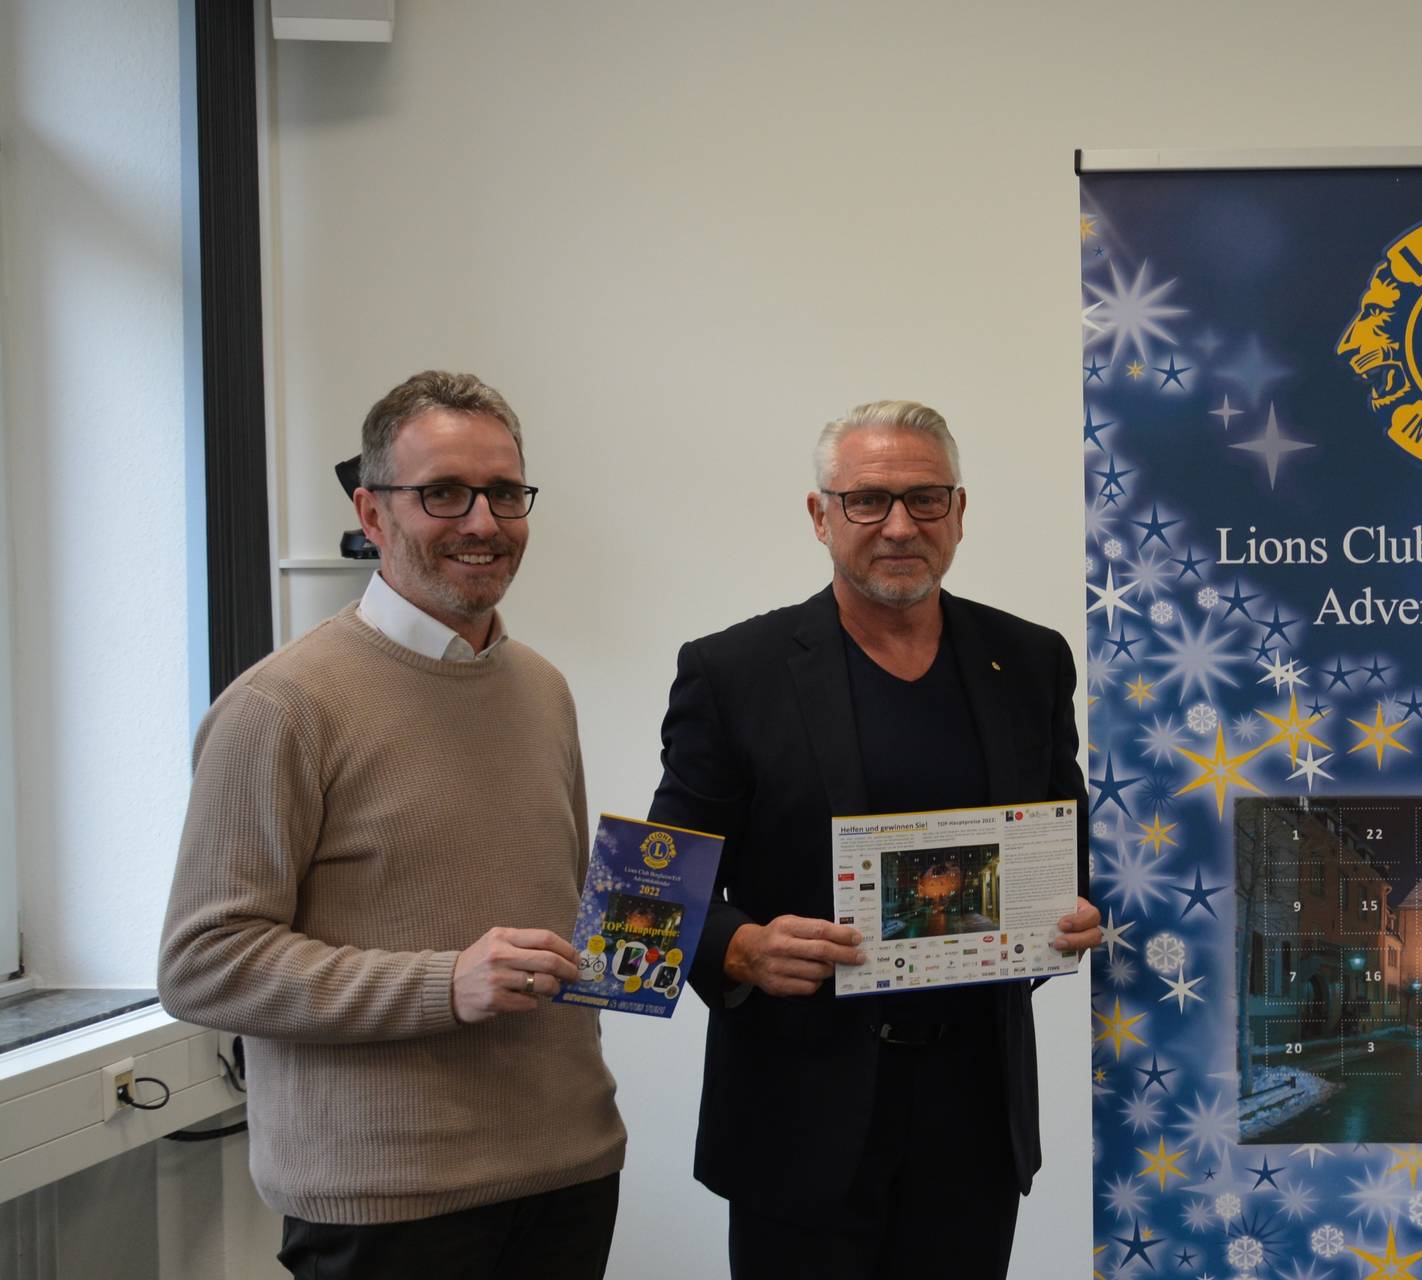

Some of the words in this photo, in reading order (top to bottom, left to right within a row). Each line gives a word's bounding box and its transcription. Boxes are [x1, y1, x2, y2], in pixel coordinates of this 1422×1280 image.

[1216, 526, 1328, 565] Lions
[865, 824, 879, 832] und
[880, 822, 914, 832] gewinnen
[915, 821, 928, 829] Sie!
[1292, 830, 1300, 840] 1
[1366, 829, 1383, 839] 22
[654, 843, 663, 856] L
[639, 885, 660, 896] 2022
[1293, 901, 1301, 911] 9
[1362, 901, 1378, 911] 15
[1289, 972, 1297, 982] 7
[1365, 971, 1382, 981] 16
[1286, 1043, 1302, 1053] 20
[1367, 1042, 1375, 1052] 3
